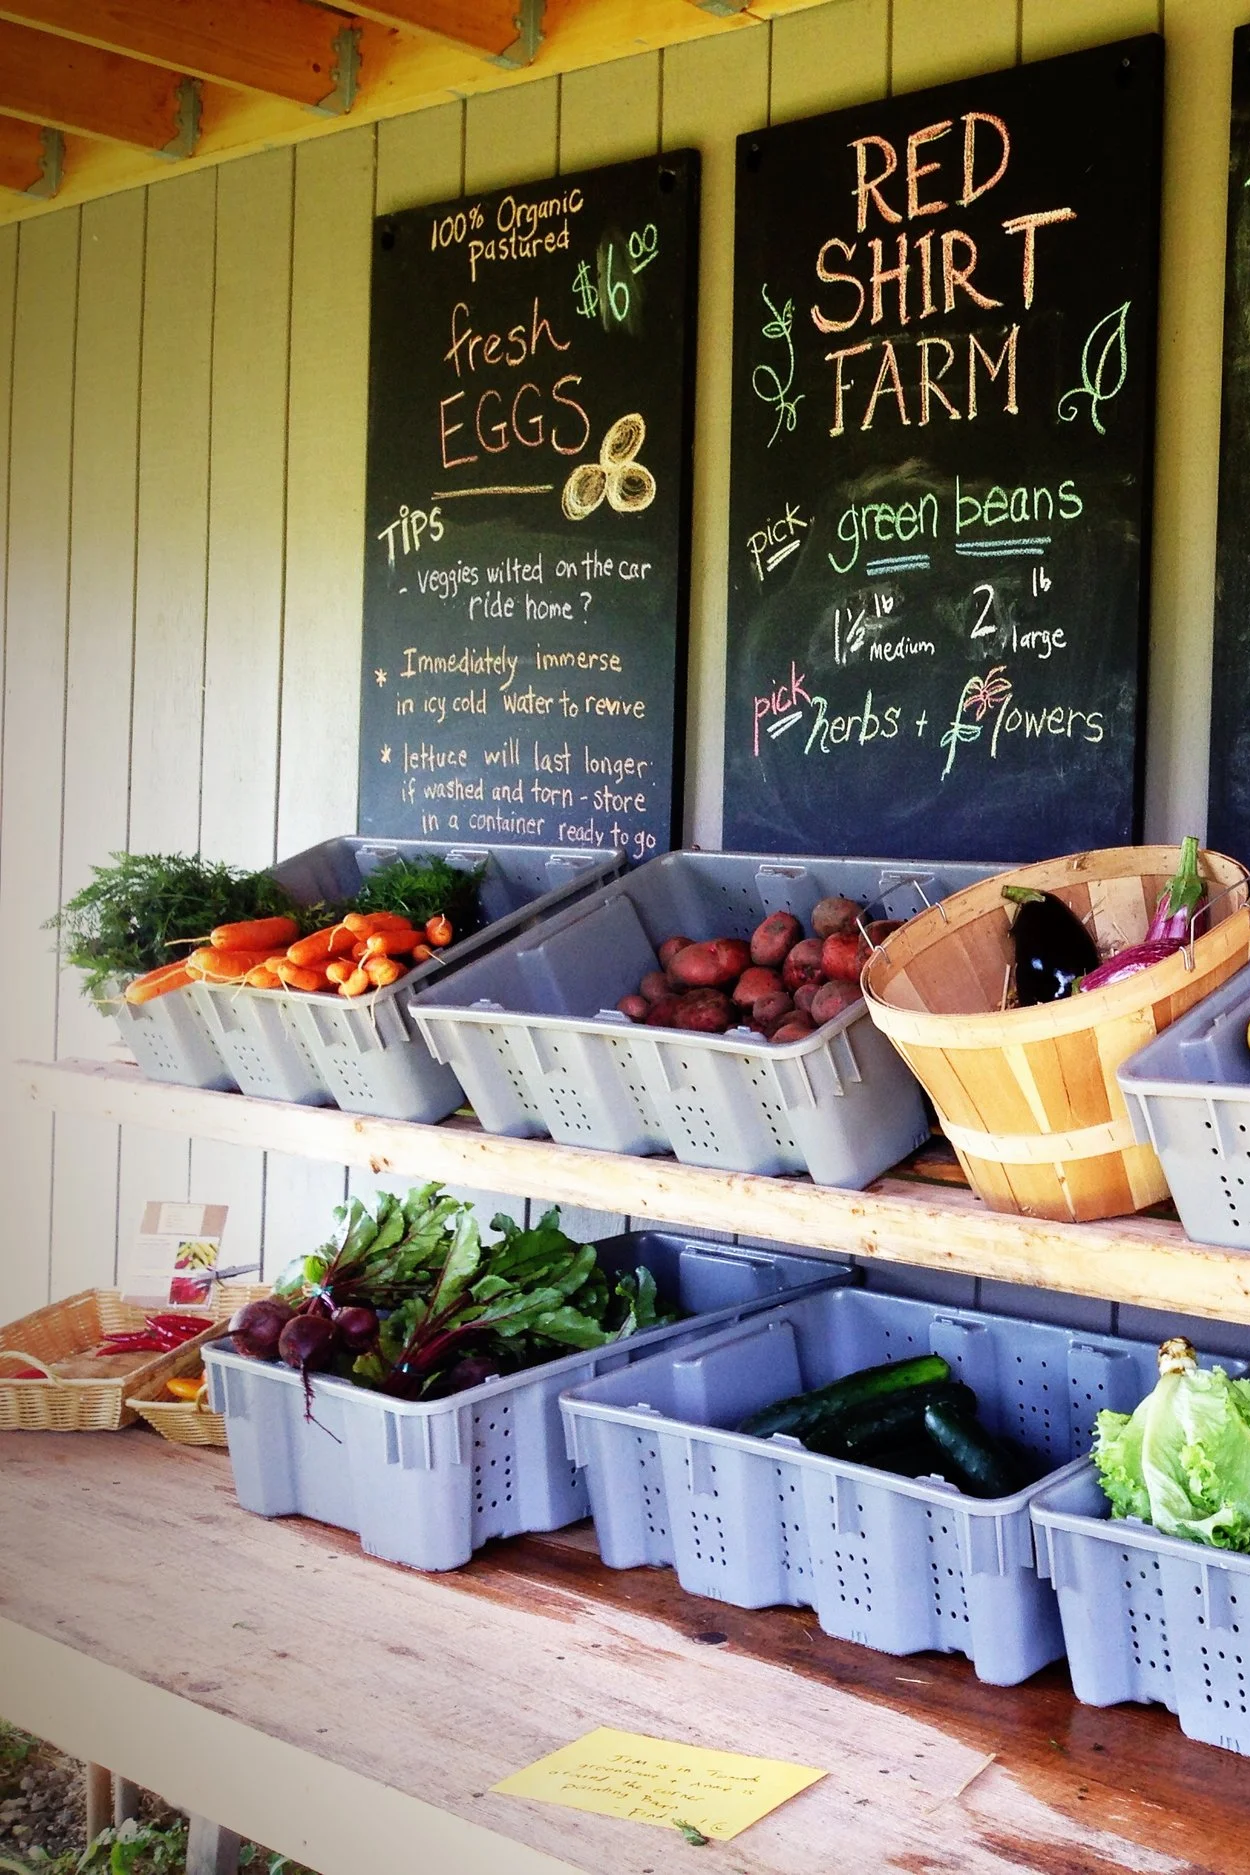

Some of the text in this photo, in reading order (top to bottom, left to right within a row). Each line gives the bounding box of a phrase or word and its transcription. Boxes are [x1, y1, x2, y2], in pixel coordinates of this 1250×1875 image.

[848, 111, 1011, 233] RED
[430, 188, 585, 252] 100% Organic
[811, 206, 1079, 334] SHIRT
[444, 296, 572, 378] fresh
[824, 322, 1021, 438] FARM
[440, 374, 591, 468] EGGS
[747, 474, 1084, 581] pick green beans
[417, 559, 480, 600] veggies
[486, 552, 543, 584] wilted
[555, 559, 579, 579] on
[581, 549, 614, 577] the
[618, 559, 652, 581] car
[468, 590, 515, 621] ride
[970, 583, 998, 639] 2
[400, 642, 623, 691] Immediately immerse
[1012, 626, 1067, 659] large
[396, 684, 647, 723] in icy cold water to revive
[754, 661, 813, 758] pick
[803, 689, 902, 755] herbs
[940, 670, 1104, 781] flowers
[403, 736, 648, 785] lettuce will last longer
[401, 778, 417, 806] if
[423, 776, 484, 801] washed
[491, 778, 525, 804] and
[530, 777, 574, 807] torn
[593, 784, 647, 814] store
[421, 808, 657, 860] in a container ready to go
